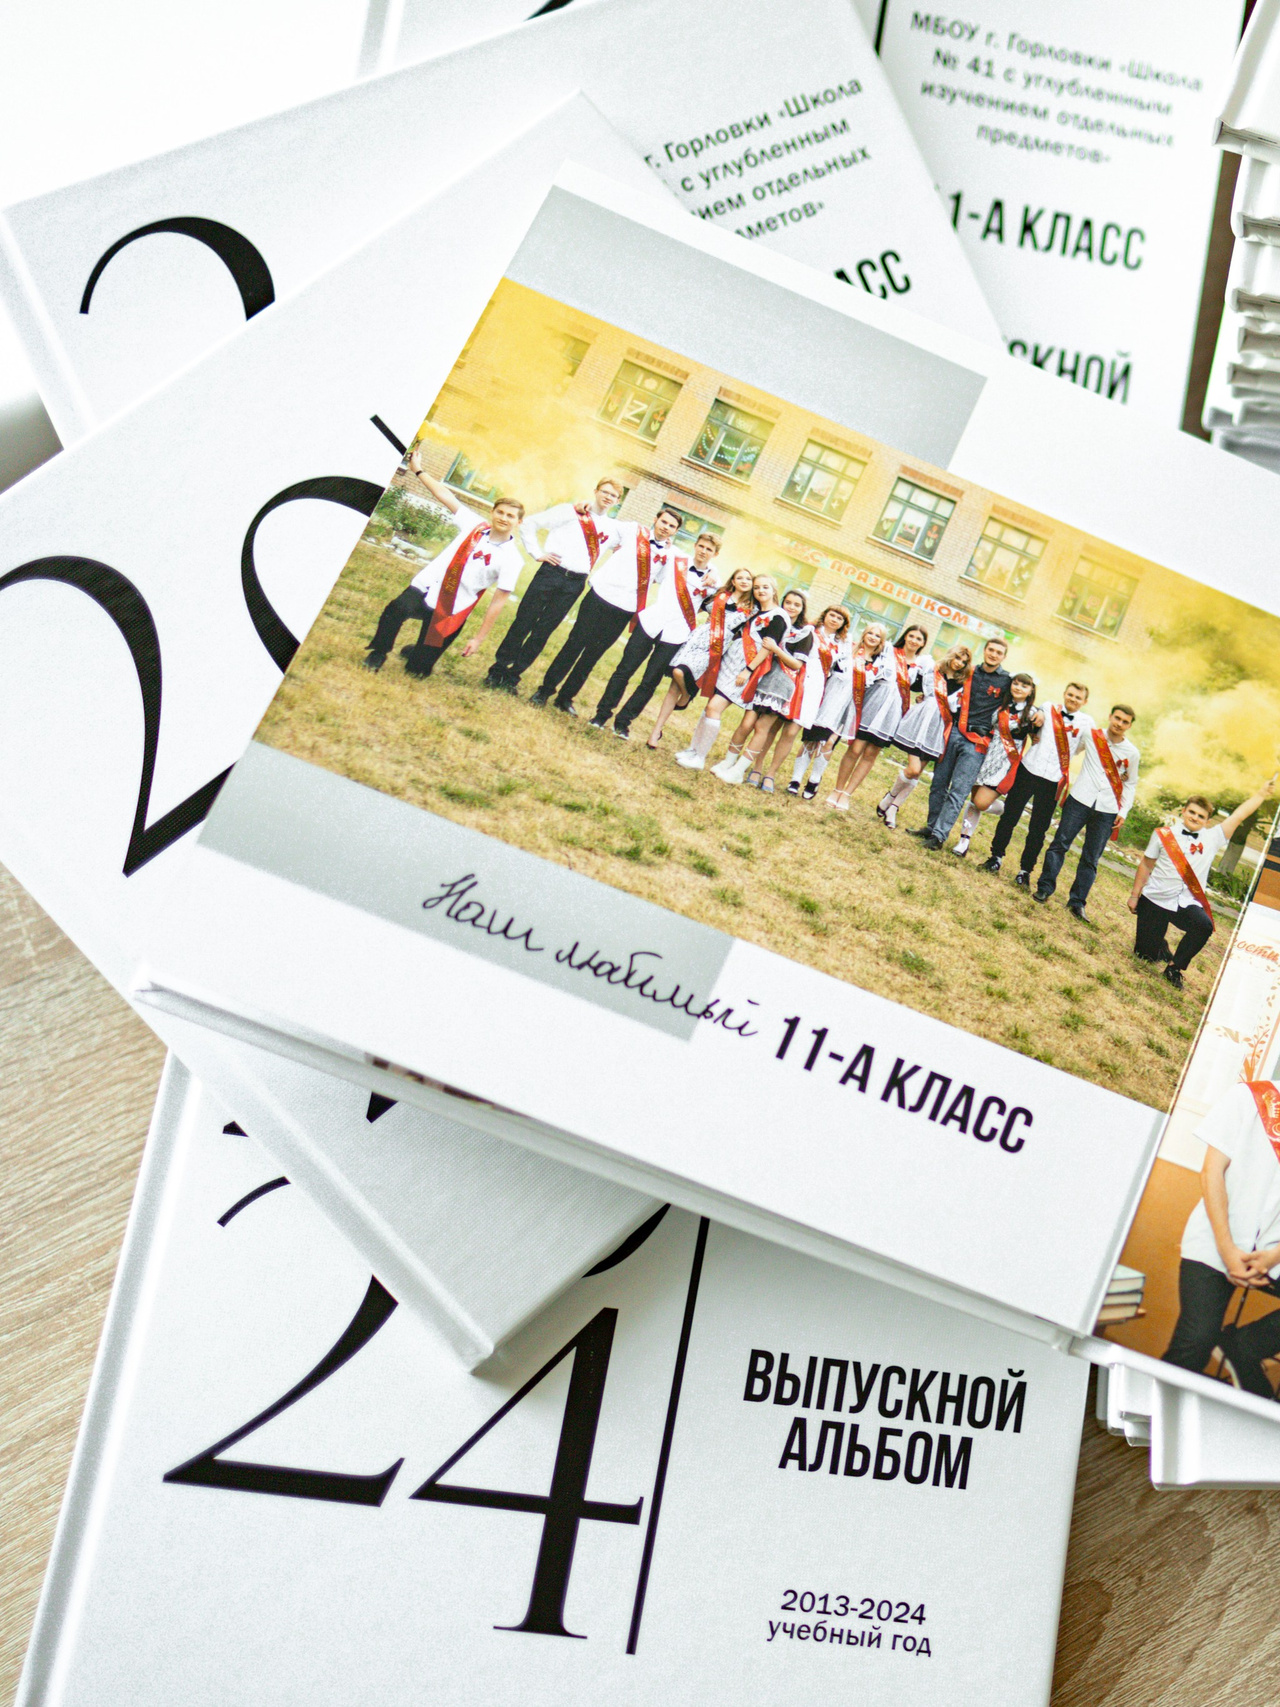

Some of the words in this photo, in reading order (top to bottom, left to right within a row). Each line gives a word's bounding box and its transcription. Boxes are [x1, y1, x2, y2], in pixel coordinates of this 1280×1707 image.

[910, 11, 980, 41] МБОУ
[1007, 32, 1112, 71] Горловки
[966, 55, 996, 79] 41
[920, 81, 1050, 120] изучением
[664, 111, 772, 163] Горловки
[681, 176, 695, 192] с
[699, 118, 851, 190] углубленным
[752, 146, 872, 201] отдельных
[1018, 204, 1146, 270] КЛАСС
[422, 873, 545, 951] Наш
[554, 941, 760, 1037] любимый
[775, 1015, 876, 1094] 11-А
[879, 1057, 1035, 1155] КЛАСС
[742, 1348, 1029, 1434] ВЫПУСКНОЙ
[778, 1416, 974, 1491] АЛЬБОМ
[780, 1589, 927, 1626] 2013-2024
[766, 1617, 882, 1649] учебный
[890, 1634, 933, 1658] год
